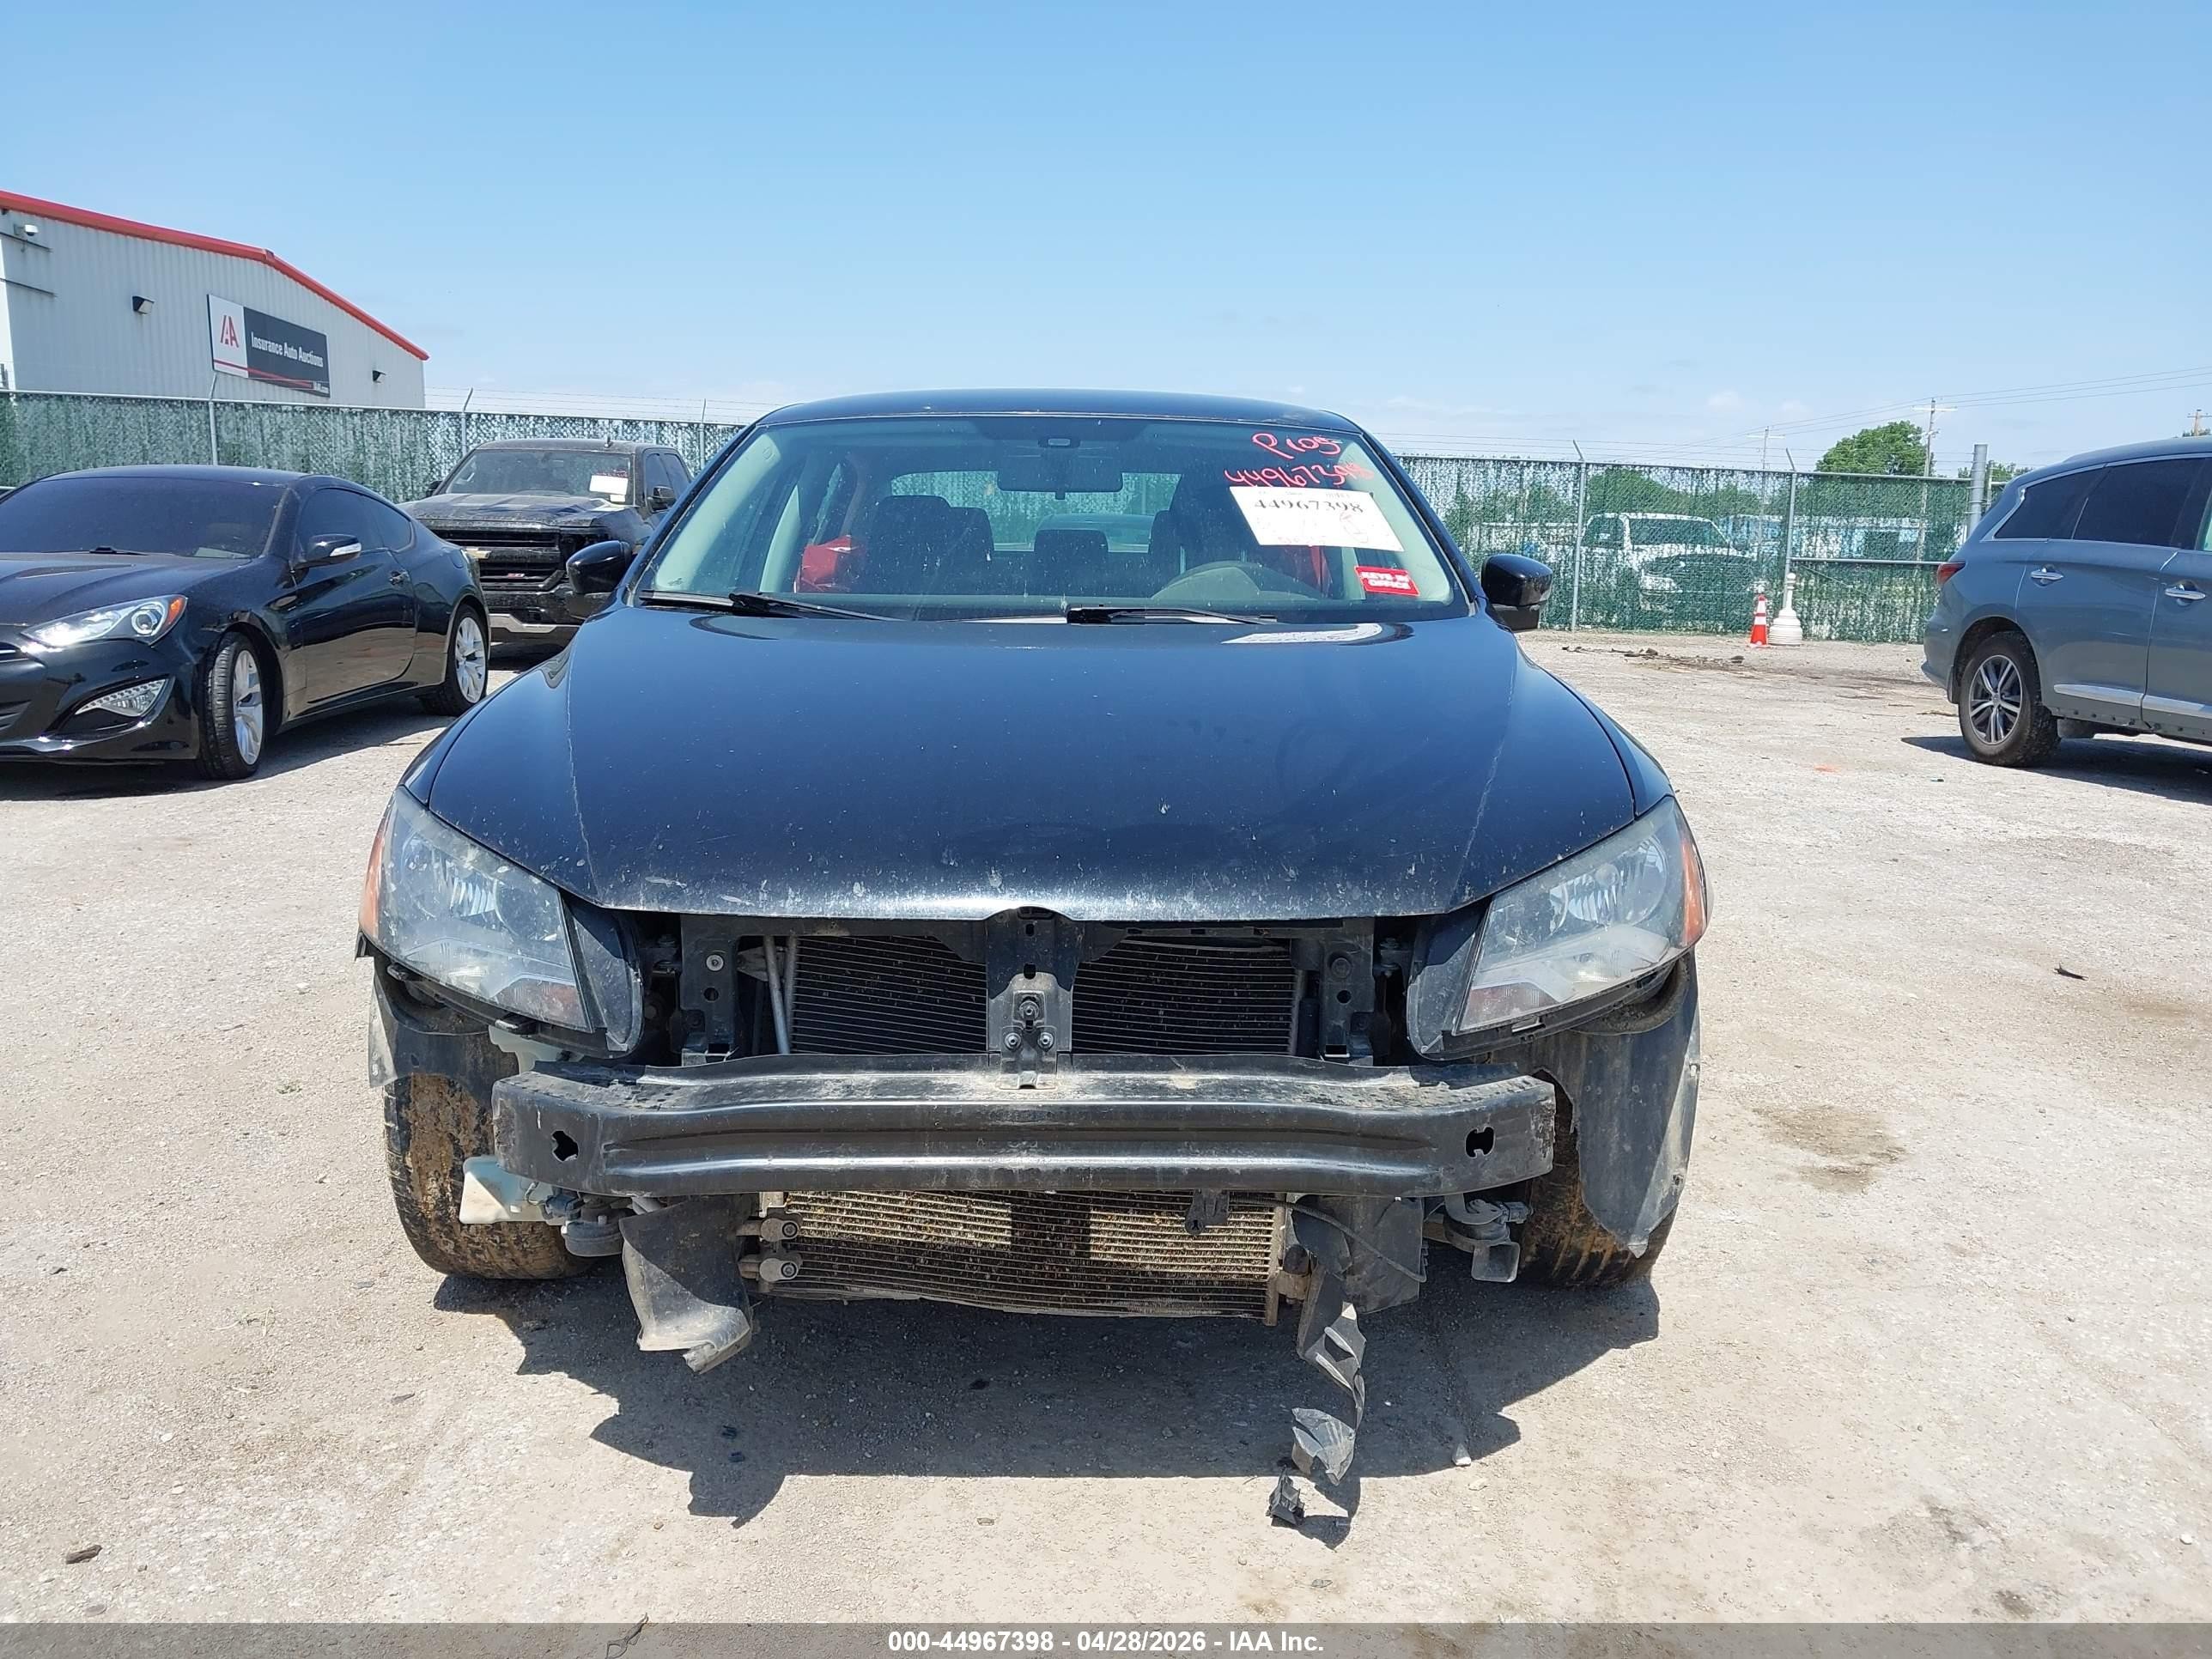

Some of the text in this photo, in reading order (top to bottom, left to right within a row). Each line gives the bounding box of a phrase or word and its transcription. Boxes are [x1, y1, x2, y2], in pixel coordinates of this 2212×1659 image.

[251, 331, 324, 368] Insurance Auto Auctions
